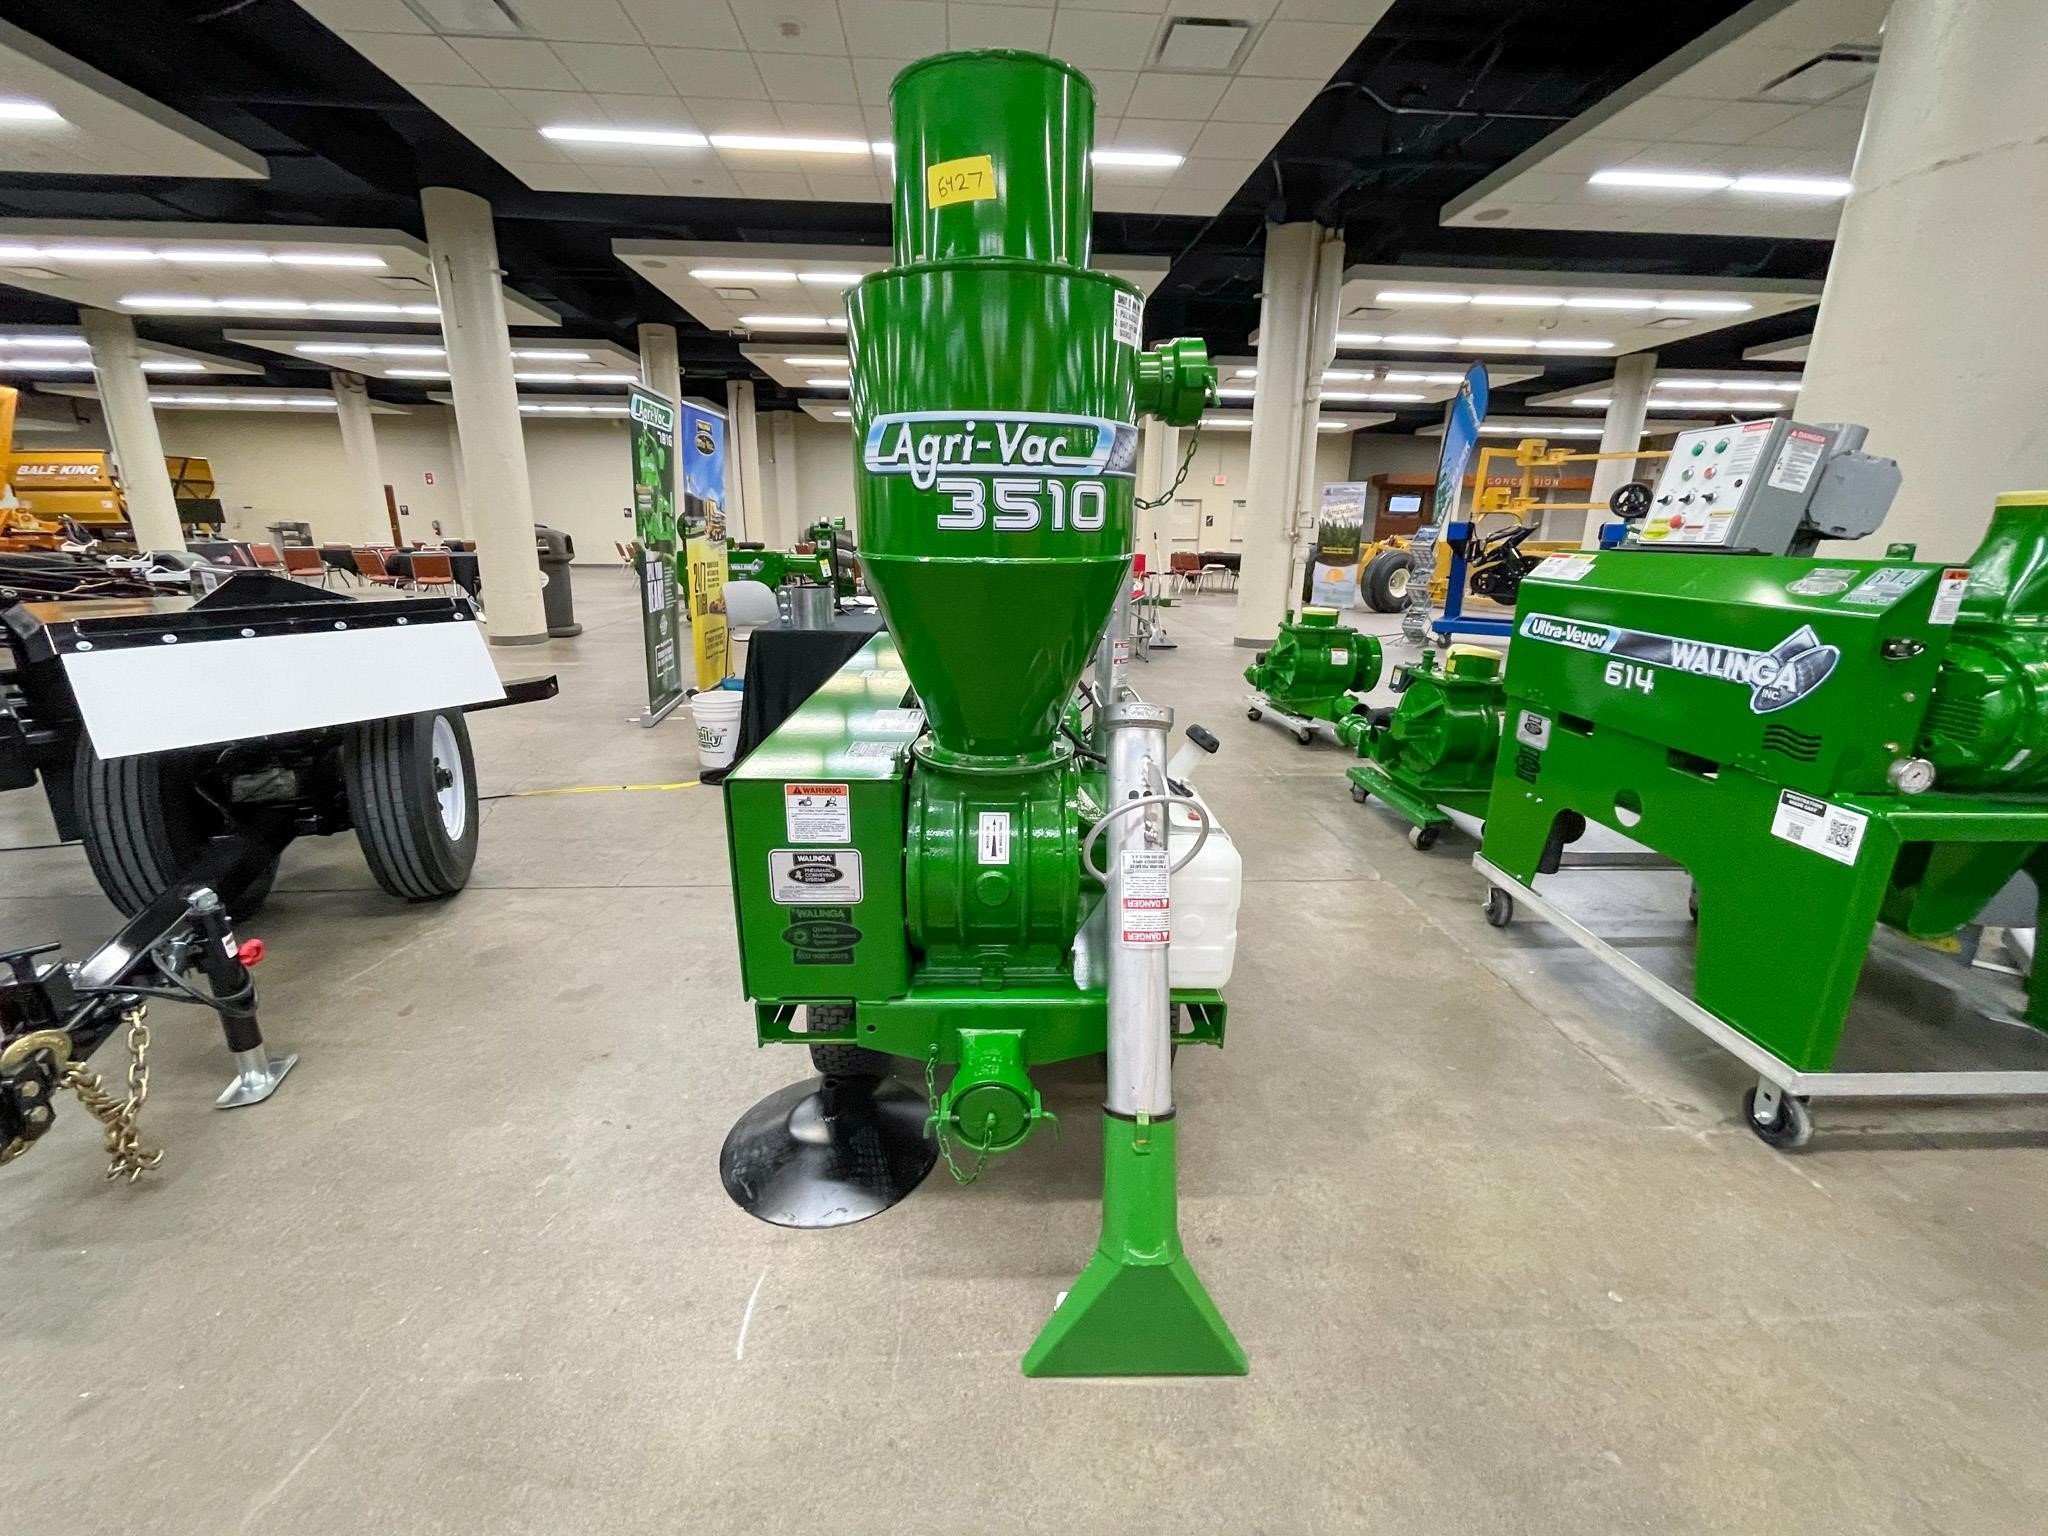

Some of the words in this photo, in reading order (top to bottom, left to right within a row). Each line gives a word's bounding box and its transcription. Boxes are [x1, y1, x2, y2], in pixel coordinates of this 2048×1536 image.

[938, 171, 982, 198] 6427
[884, 420, 1090, 490] Agri-Vac
[16, 465, 59, 475] BALE
[60, 465, 100, 475] KING
[937, 478, 1105, 531] 3510
[1532, 619, 1607, 647] Ultra-Veyor
[1604, 660, 1655, 694] 614
[1671, 641, 1798, 693] WALINGA
[1761, 689, 1781, 701] INC.
[797, 910, 846, 918] WALINGA
[1127, 932, 1161, 941] DANGER
